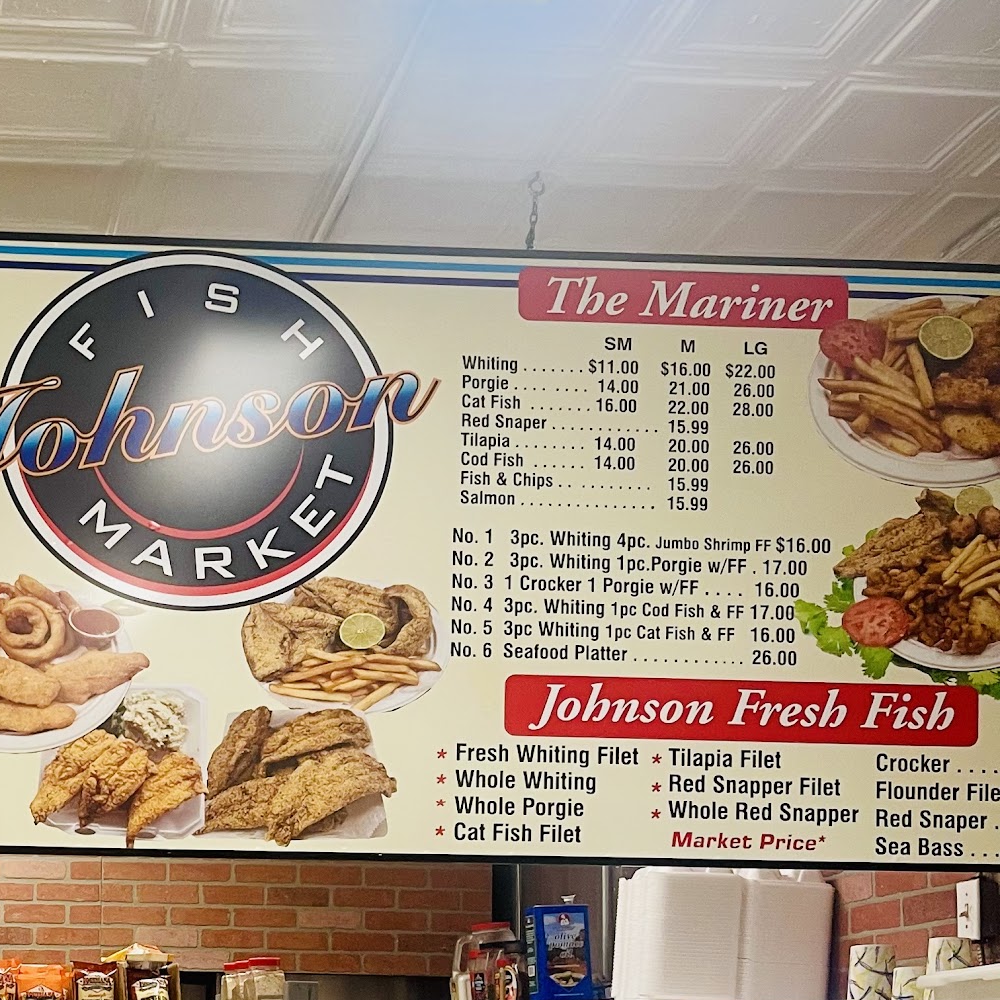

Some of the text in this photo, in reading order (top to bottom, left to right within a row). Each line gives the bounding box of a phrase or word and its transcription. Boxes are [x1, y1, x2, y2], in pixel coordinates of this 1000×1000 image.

[546, 276, 833, 323] The Mariner
[68, 283, 324, 360] FISH
[604, 336, 768, 356] SM M LG
[462, 355, 776, 379] Whiting $11.00 $16.00 $22.00
[462, 374, 775, 398] Porgie 14.00 21.00 26.00
[79, 454, 354, 579] MARKET
[452, 527, 831, 555] No. 1 3pc. Whiting 4pc. Jumbo Shrimp FF $16.00
[450, 641, 797, 666] No. 6 Seafood Platter 26.00
[528, 684, 955, 732] Johnson Fresh Fish
[668, 747, 781, 771] Tilapia Filet
[876, 753, 951, 773] Crocker
[876, 780, 1000, 802] Flounder File
[668, 800, 860, 827] Whole Red Snapper
[671, 832, 753, 849] Market
[875, 836, 964, 857] Sea Bass
